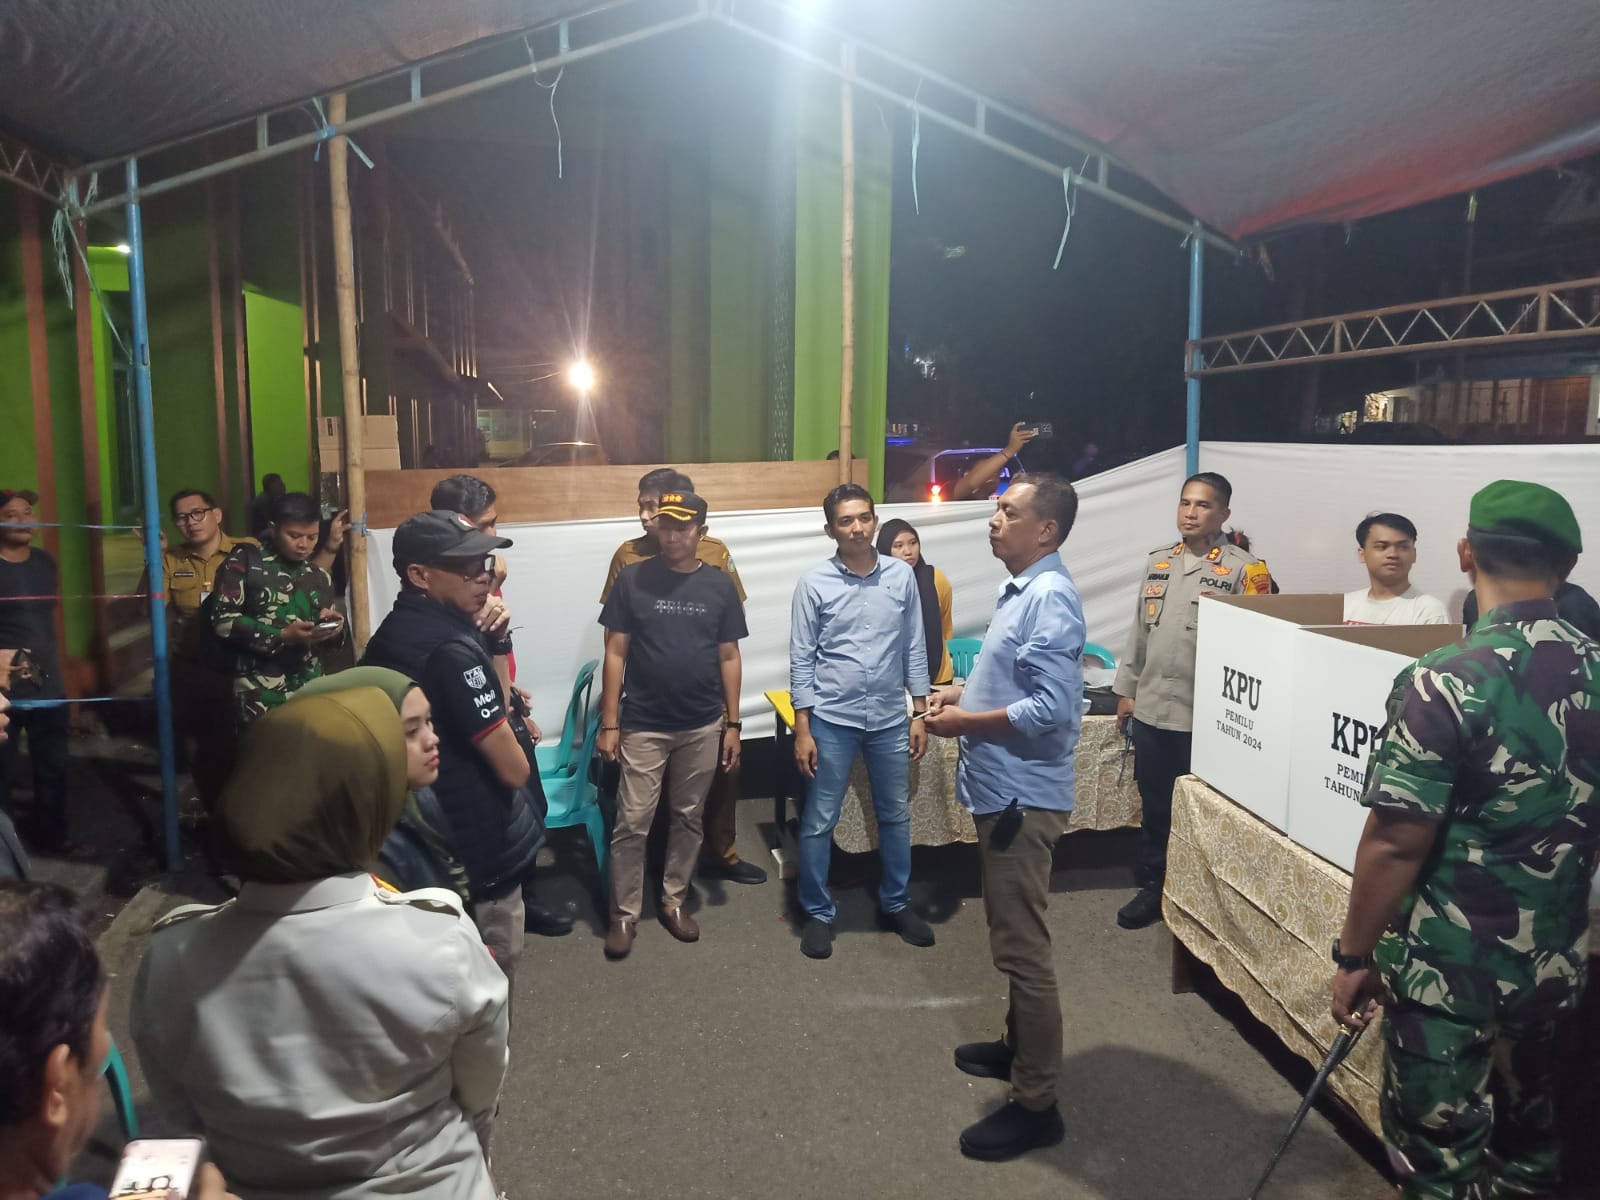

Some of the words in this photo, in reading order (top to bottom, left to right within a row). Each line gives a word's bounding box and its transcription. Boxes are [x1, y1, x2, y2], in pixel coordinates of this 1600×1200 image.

[1200, 577, 1232, 591] POLRI
[1222, 666, 1261, 711] KPU
[1225, 709, 1254, 730] PEMILU
[1216, 720, 1242, 741] TAHUN
[1242, 734, 1262, 752] 2024
[1337, 763, 1364, 785] PEMI
[1324, 776, 1360, 802] TAHUN
